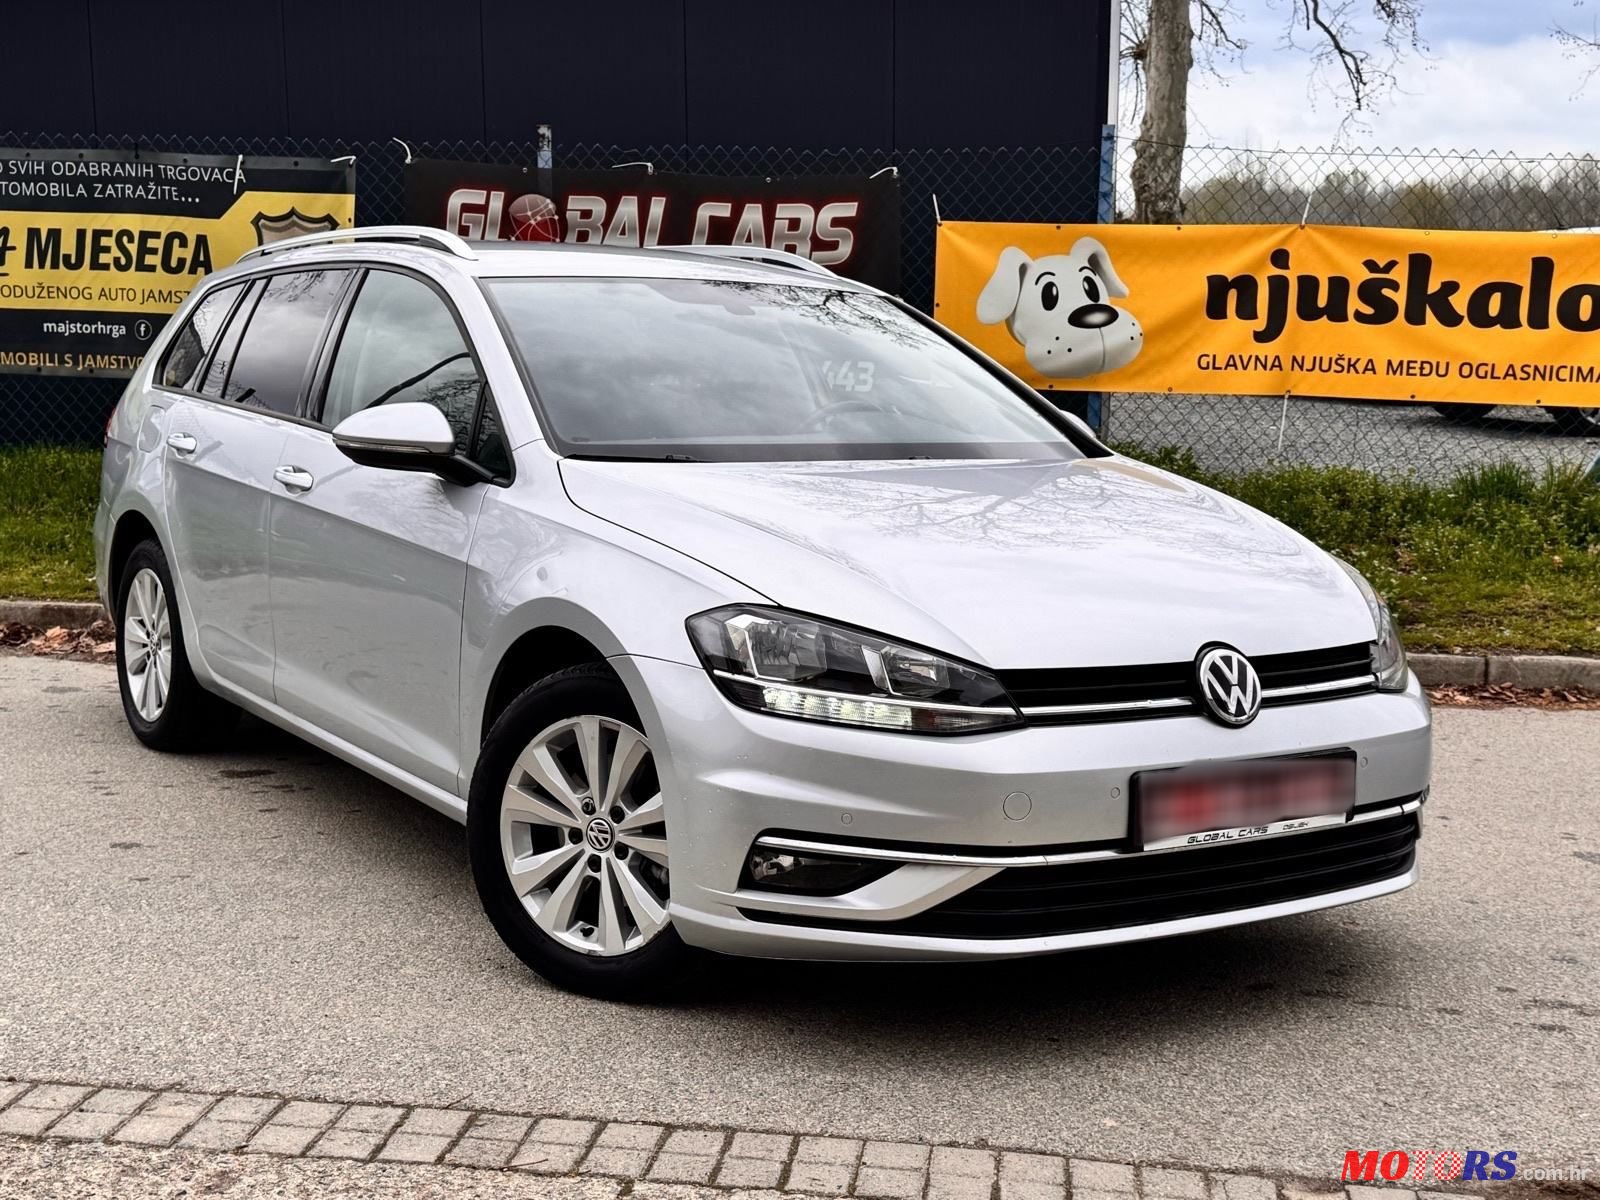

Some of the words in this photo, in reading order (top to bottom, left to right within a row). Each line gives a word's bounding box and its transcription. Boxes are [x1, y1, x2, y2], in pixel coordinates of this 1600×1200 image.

[8, 160, 45, 175] SVIH
[51, 161, 154, 178] ODABRANIH
[158, 164, 247, 183] TRGOVACA
[692, 202, 858, 265] CARS
[24, 227, 213, 276] MJESECA
[0, 282, 93, 300] ODUŽENOG
[98, 287, 137, 301] AUTO
[1205, 248, 1600, 343] njuškalo
[43, 320, 127, 338] majstorhrga
[64, 353, 73, 367] S
[1197, 353, 1284, 371] GLAVNA
[1290, 353, 1377, 375] NJUŠKA
[1385, 359, 1450, 378] MEĐU
[1187, 831, 1234, 844] GLOBAL
[1238, 826, 1268, 837] CARS
